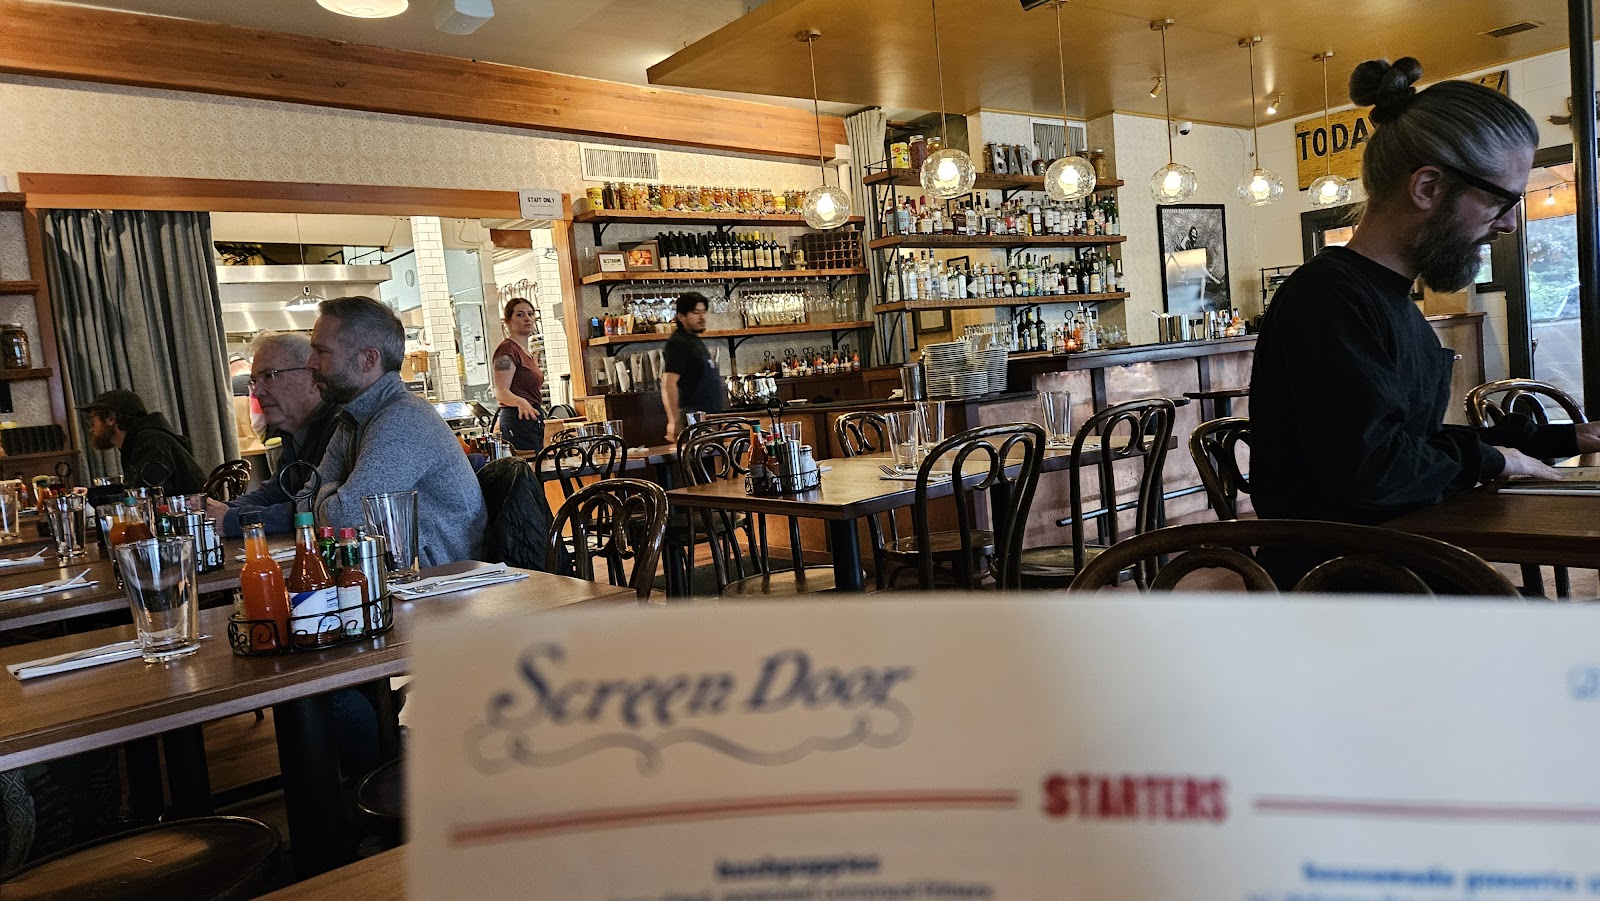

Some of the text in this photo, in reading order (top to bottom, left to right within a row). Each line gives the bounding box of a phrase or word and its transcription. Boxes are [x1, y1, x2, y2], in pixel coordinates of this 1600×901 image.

[990, 145, 1034, 176] BAR
[1297, 117, 1375, 161] TODA
[487, 641, 914, 727] Screen Door
[1043, 773, 1227, 822] STARTERS
